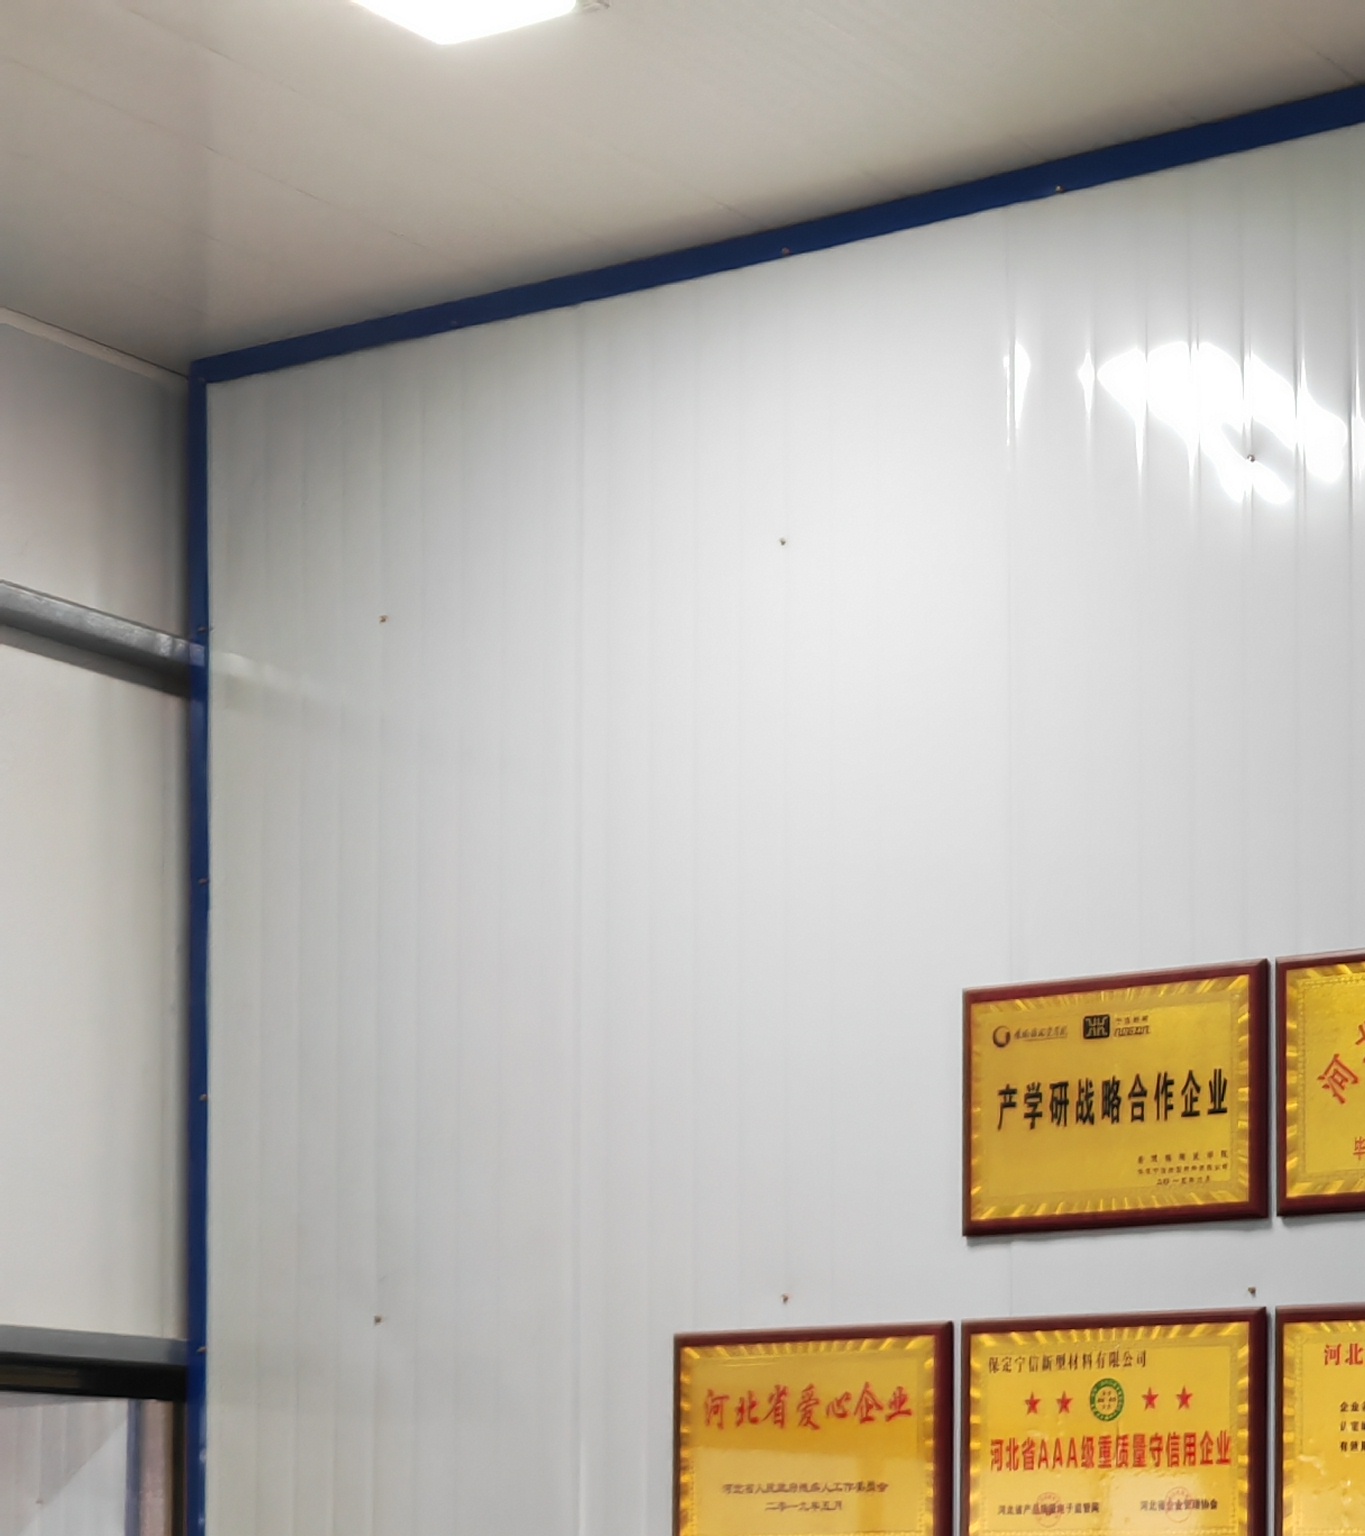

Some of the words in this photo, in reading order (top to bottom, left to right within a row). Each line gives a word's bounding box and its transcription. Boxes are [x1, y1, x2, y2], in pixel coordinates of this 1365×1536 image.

[997, 1068, 1228, 1131] 产学研战略合作企业
[988, 1350, 1148, 1374] 保定宁信新型材料有限公司
[704, 1381, 913, 1431] 河北省爱心企业
[990, 1430, 1232, 1472] 河北省AAA级重质量守信用企业
